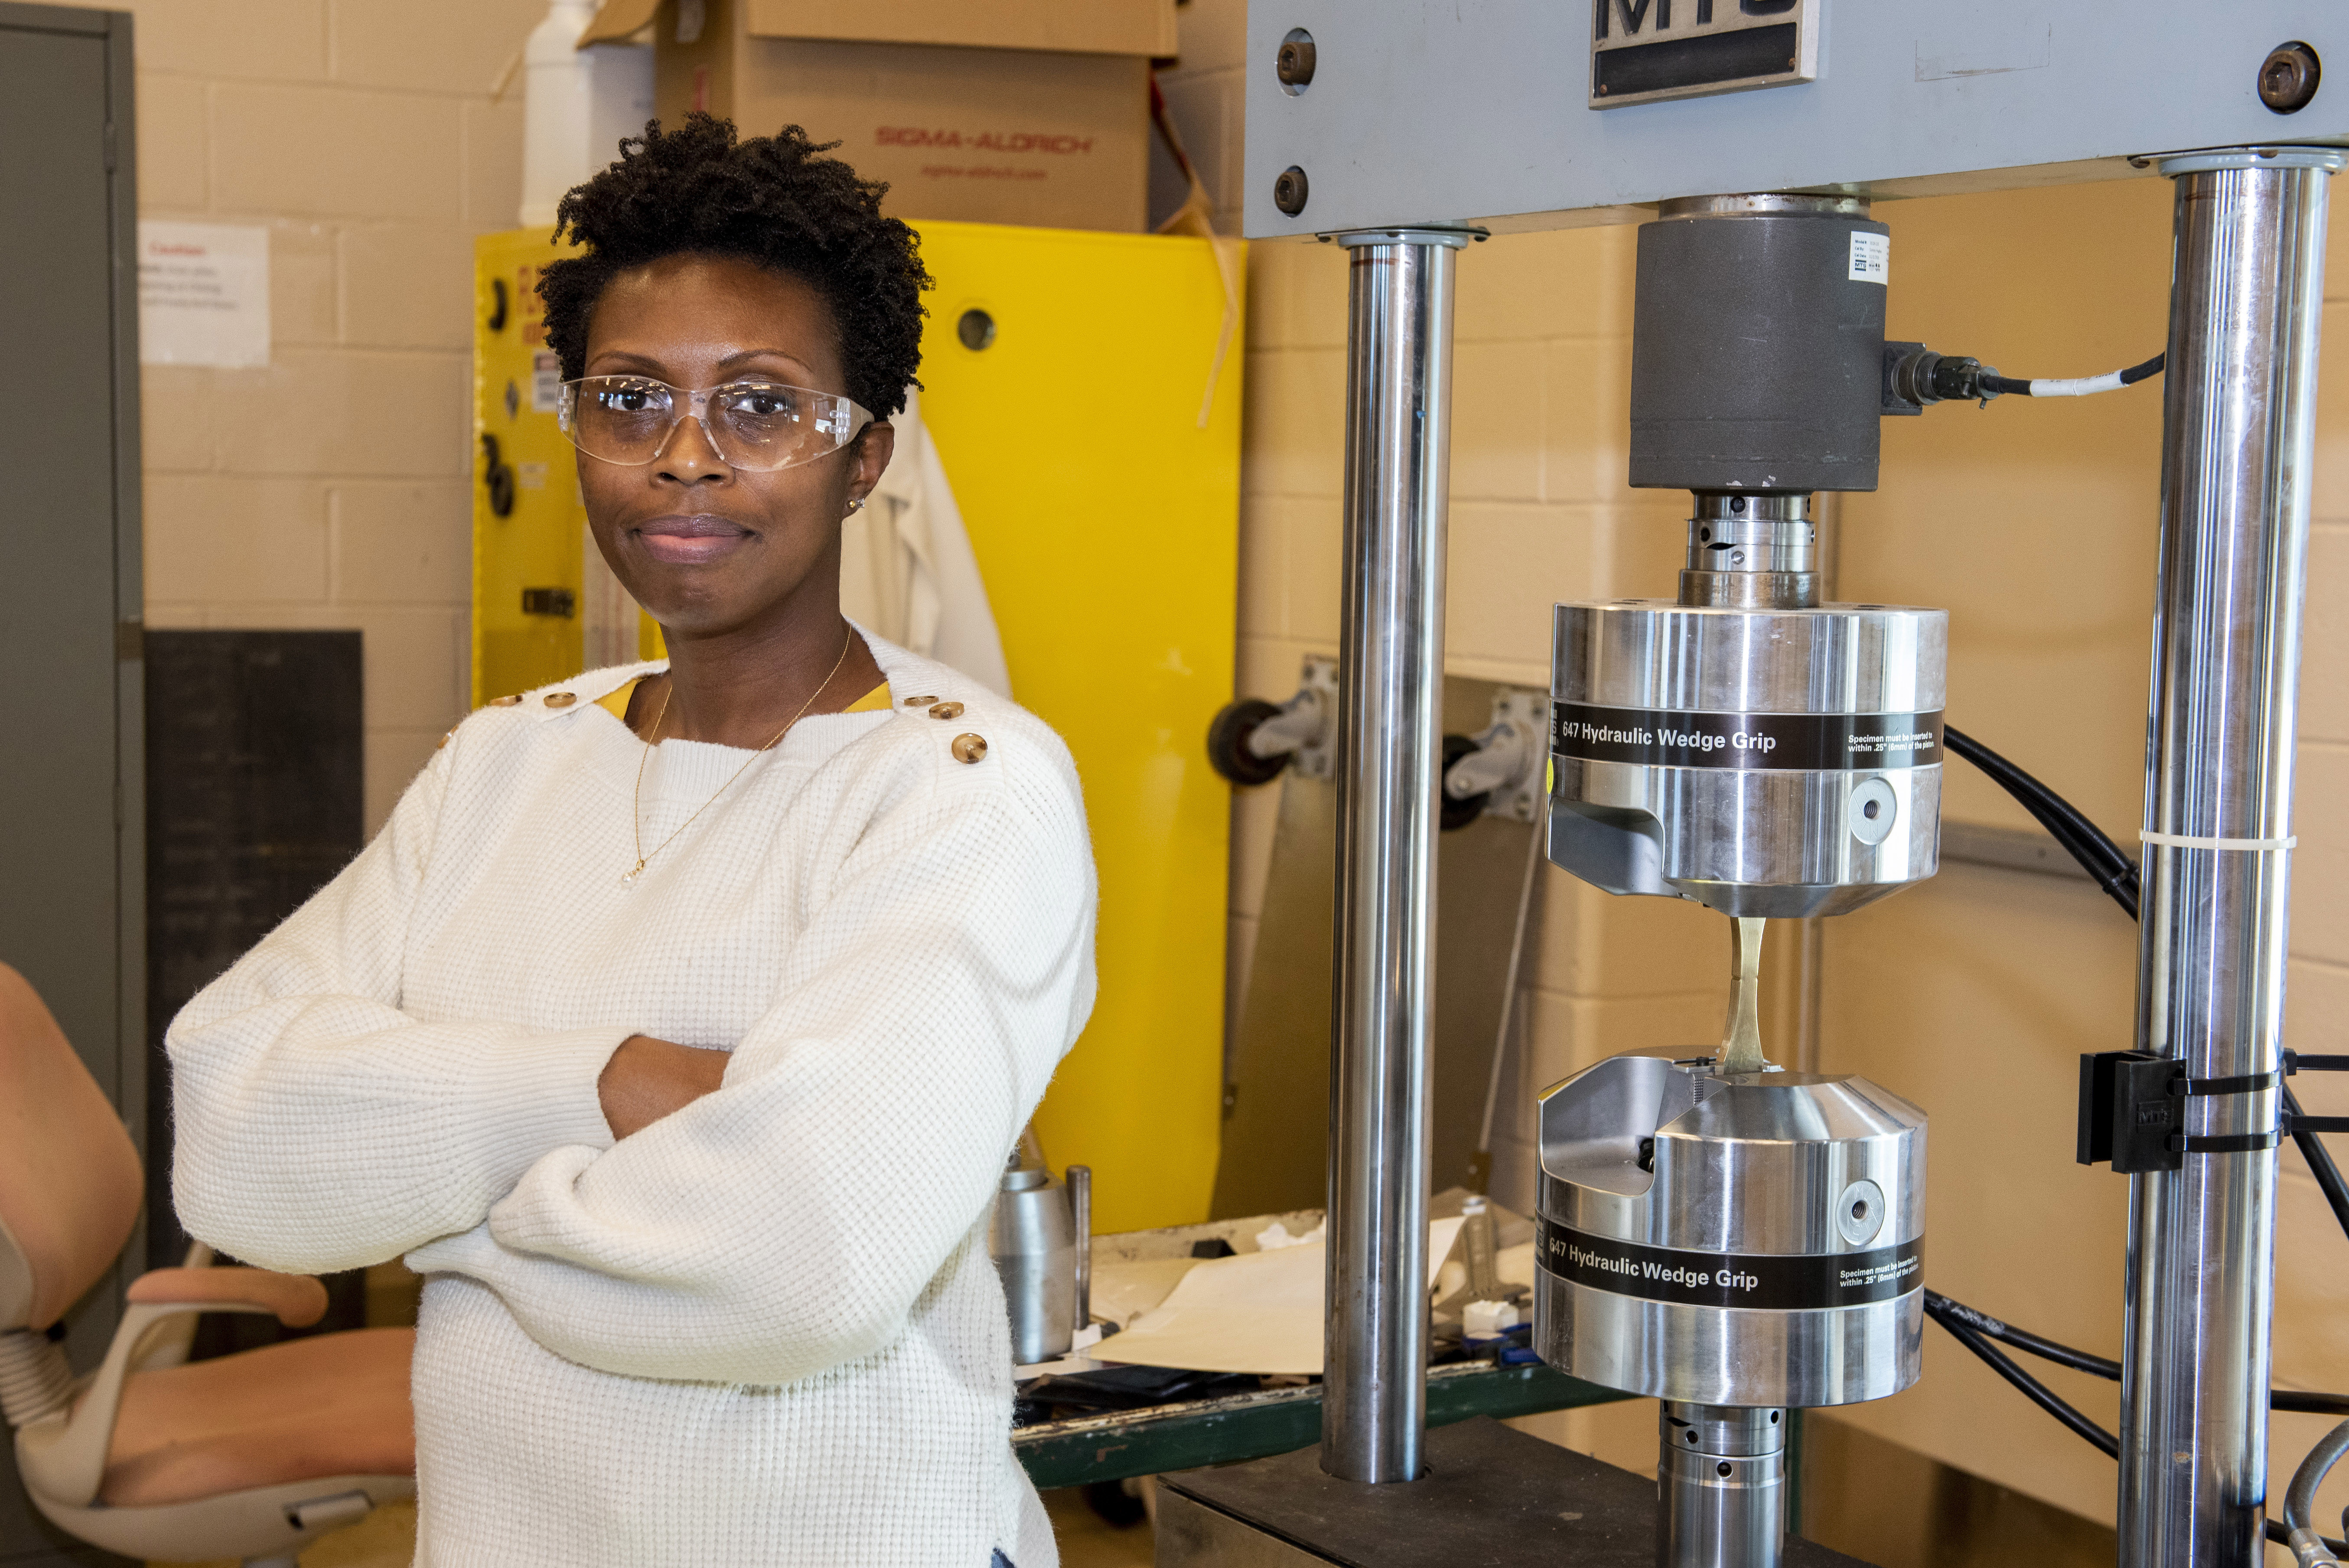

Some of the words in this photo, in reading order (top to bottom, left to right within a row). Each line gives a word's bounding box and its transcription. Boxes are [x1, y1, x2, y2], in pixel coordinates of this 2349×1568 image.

[876, 127, 1093, 154] SIGMA-ALDRICH
[1563, 721, 1579, 737] 647
[1582, 723, 1652, 745] Hydraulic
[1658, 729, 1725, 751] Wedge
[1732, 731, 1776, 753] Grip
[1848, 734, 1884, 744] Specimen
[1902, 733, 1909, 741] be
[1910, 731, 1928, 740] inserted
[1873, 743, 1887, 752] .25"
[1889, 742, 1907, 752] (6mm)
[1922, 740, 1934, 750] piston.
[1550, 1237, 1566, 1257] 647
[1569, 1244, 1639, 1276] Hydraulic
[1642, 1262, 1709, 1288] Wedge
[1715, 1269, 1758, 1291] Grip
[1840, 1268, 1873, 1279] Specimen
[1875, 1265, 1890, 1274] must
[1898, 1255, 1914, 1268] inserted
[1840, 1278, 1863, 1287] within
[1864, 1275, 1877, 1284] .25"
[1878, 1271, 1896, 1283] (6mm)
